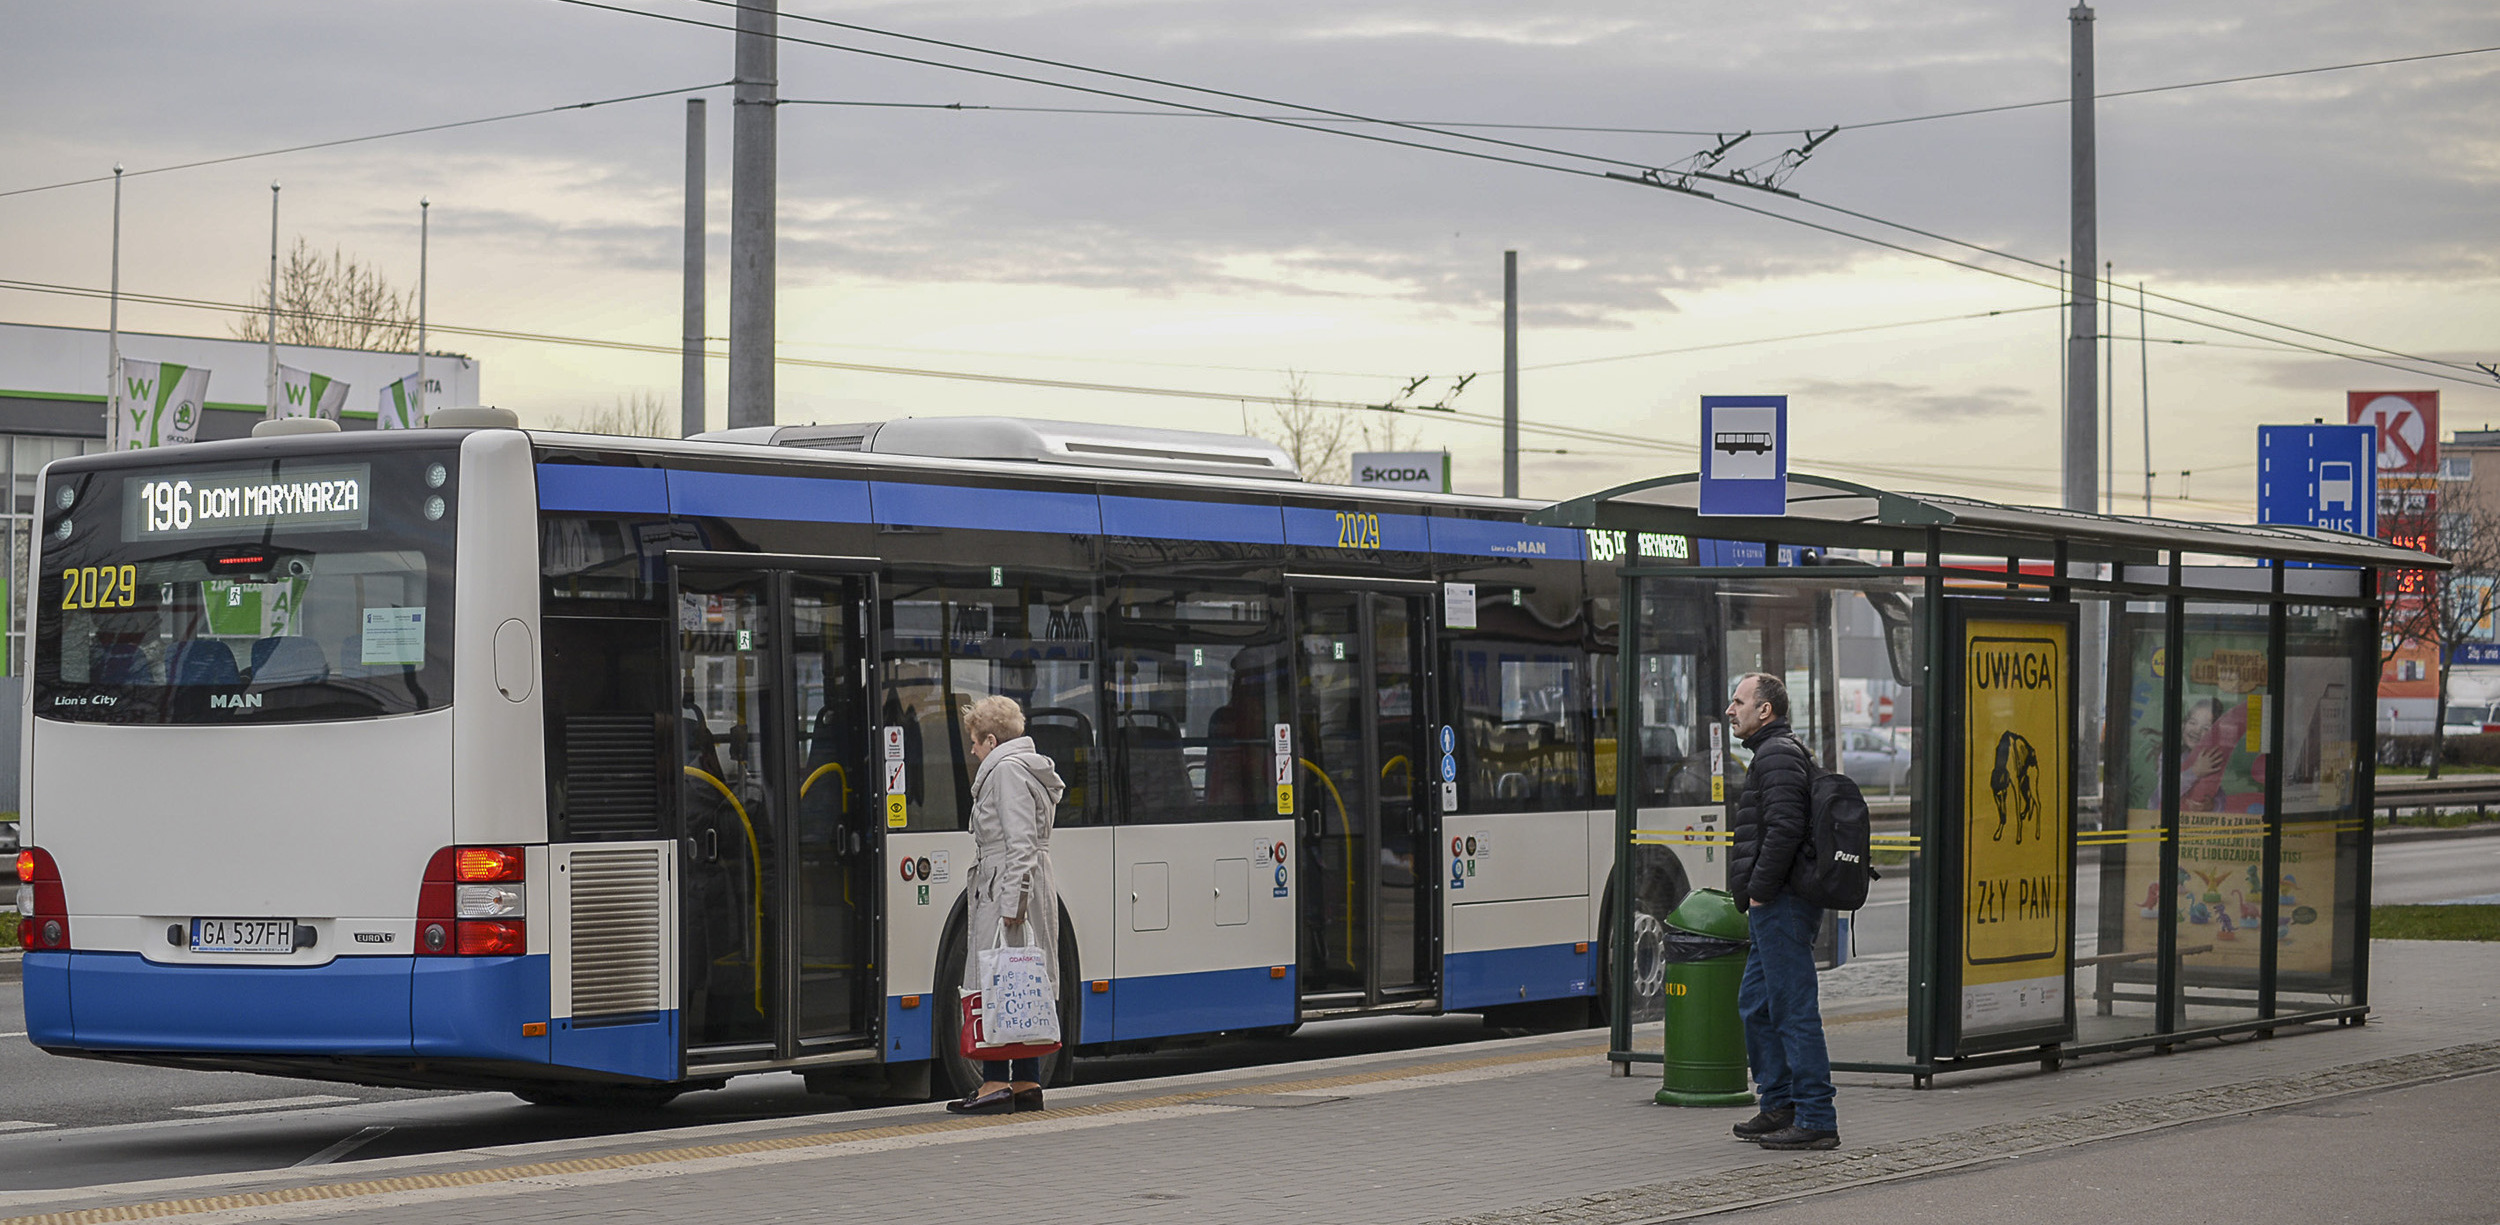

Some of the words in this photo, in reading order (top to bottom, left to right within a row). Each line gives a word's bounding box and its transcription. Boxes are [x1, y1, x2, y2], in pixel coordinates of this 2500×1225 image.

[1361, 466, 1430, 482] ŠKODA
[142, 480, 193, 532] 196
[199, 487, 240, 519] DOM
[244, 479, 359, 517] MARYNARZA
[1335, 512, 1381, 549] 2029
[2318, 518, 2353, 533] BUS
[1517, 541, 1546, 554] MAN
[61, 564, 136, 610] 2029
[1976, 651, 2052, 690] UWAGA
[54, 695, 87, 706] Lion's
[92, 694, 118, 707] City
[210, 693, 263, 709] MAN
[1834, 850, 1860, 863] Pure
[1977, 879, 2009, 924] ZŁY
[2019, 874, 2051, 921] PAN
[203, 921, 226, 945] GA
[233, 921, 290, 945] 537FH
[357, 934, 381, 943] EURO
